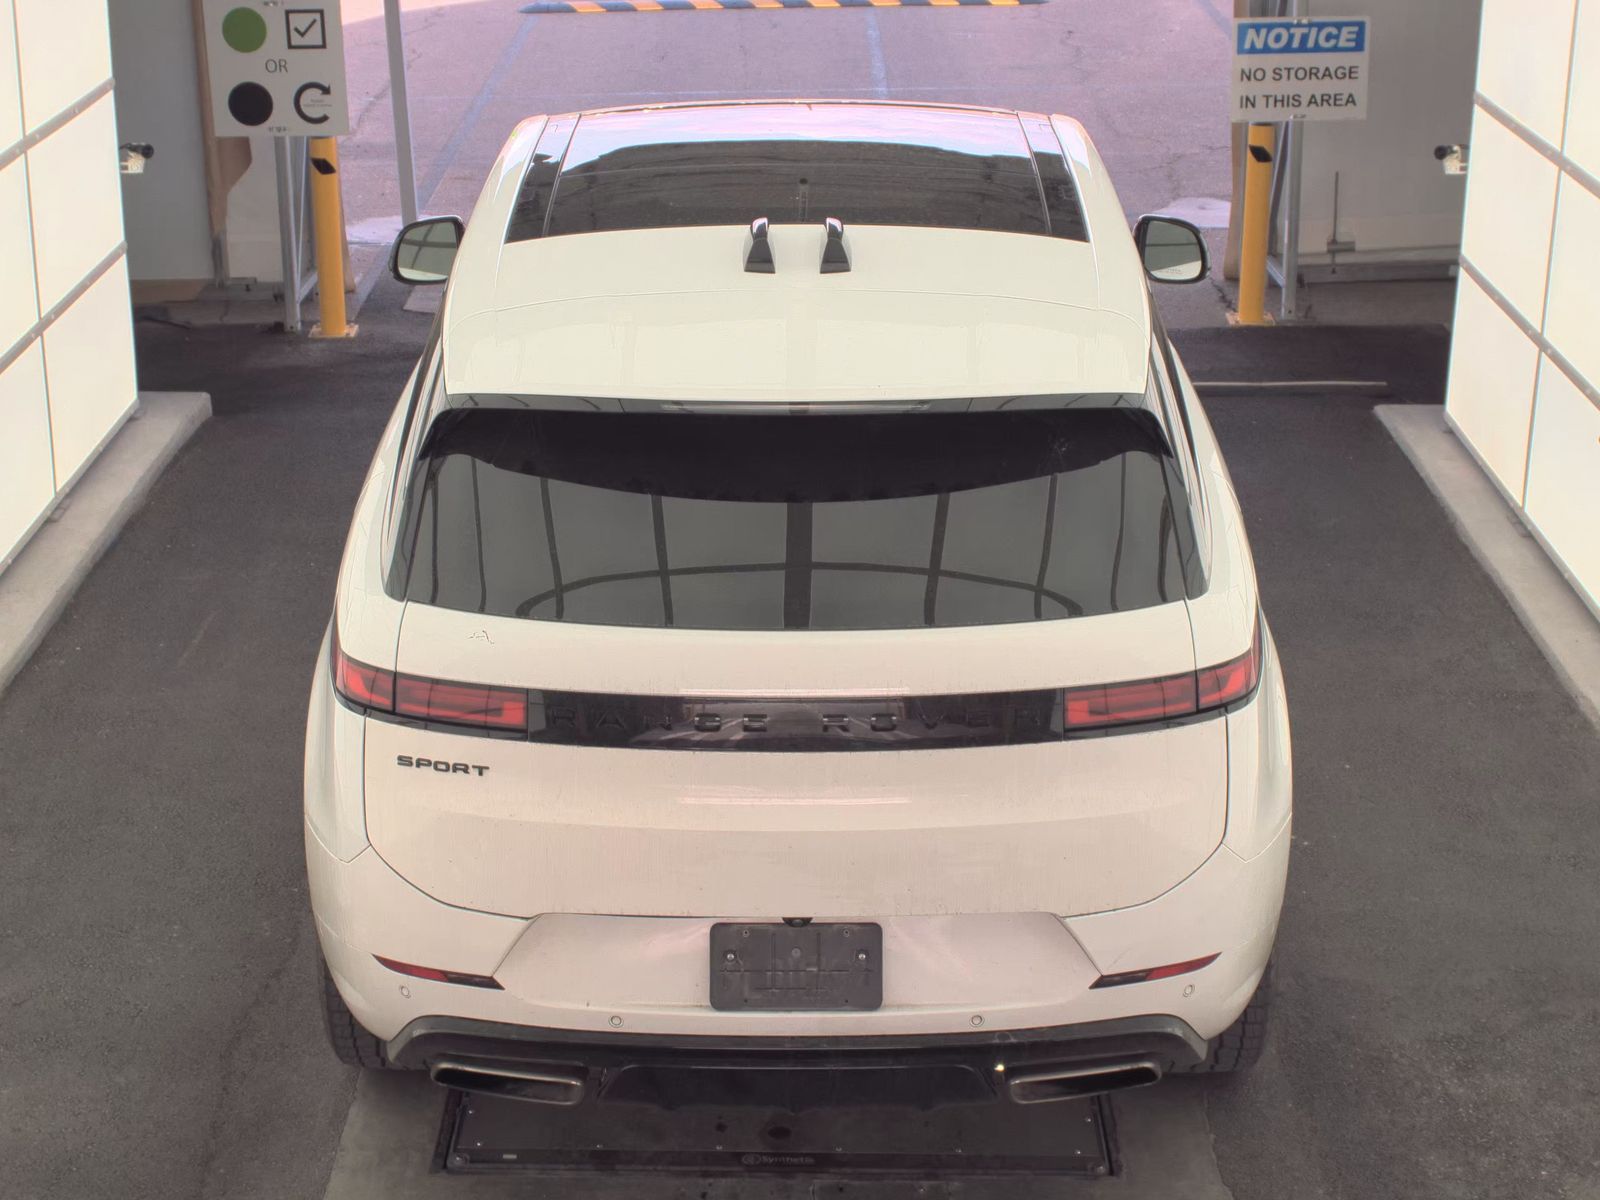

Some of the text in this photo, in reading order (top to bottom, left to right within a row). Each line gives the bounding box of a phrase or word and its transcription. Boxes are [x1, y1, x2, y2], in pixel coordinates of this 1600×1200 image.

[1244, 26, 1359, 49] NOTICE
[265, 59, 288, 73] OR
[1240, 65, 1360, 82] NO STORAGE
[1240, 93, 1357, 109] IN THIS AREA
[397, 754, 490, 777] SPORT
